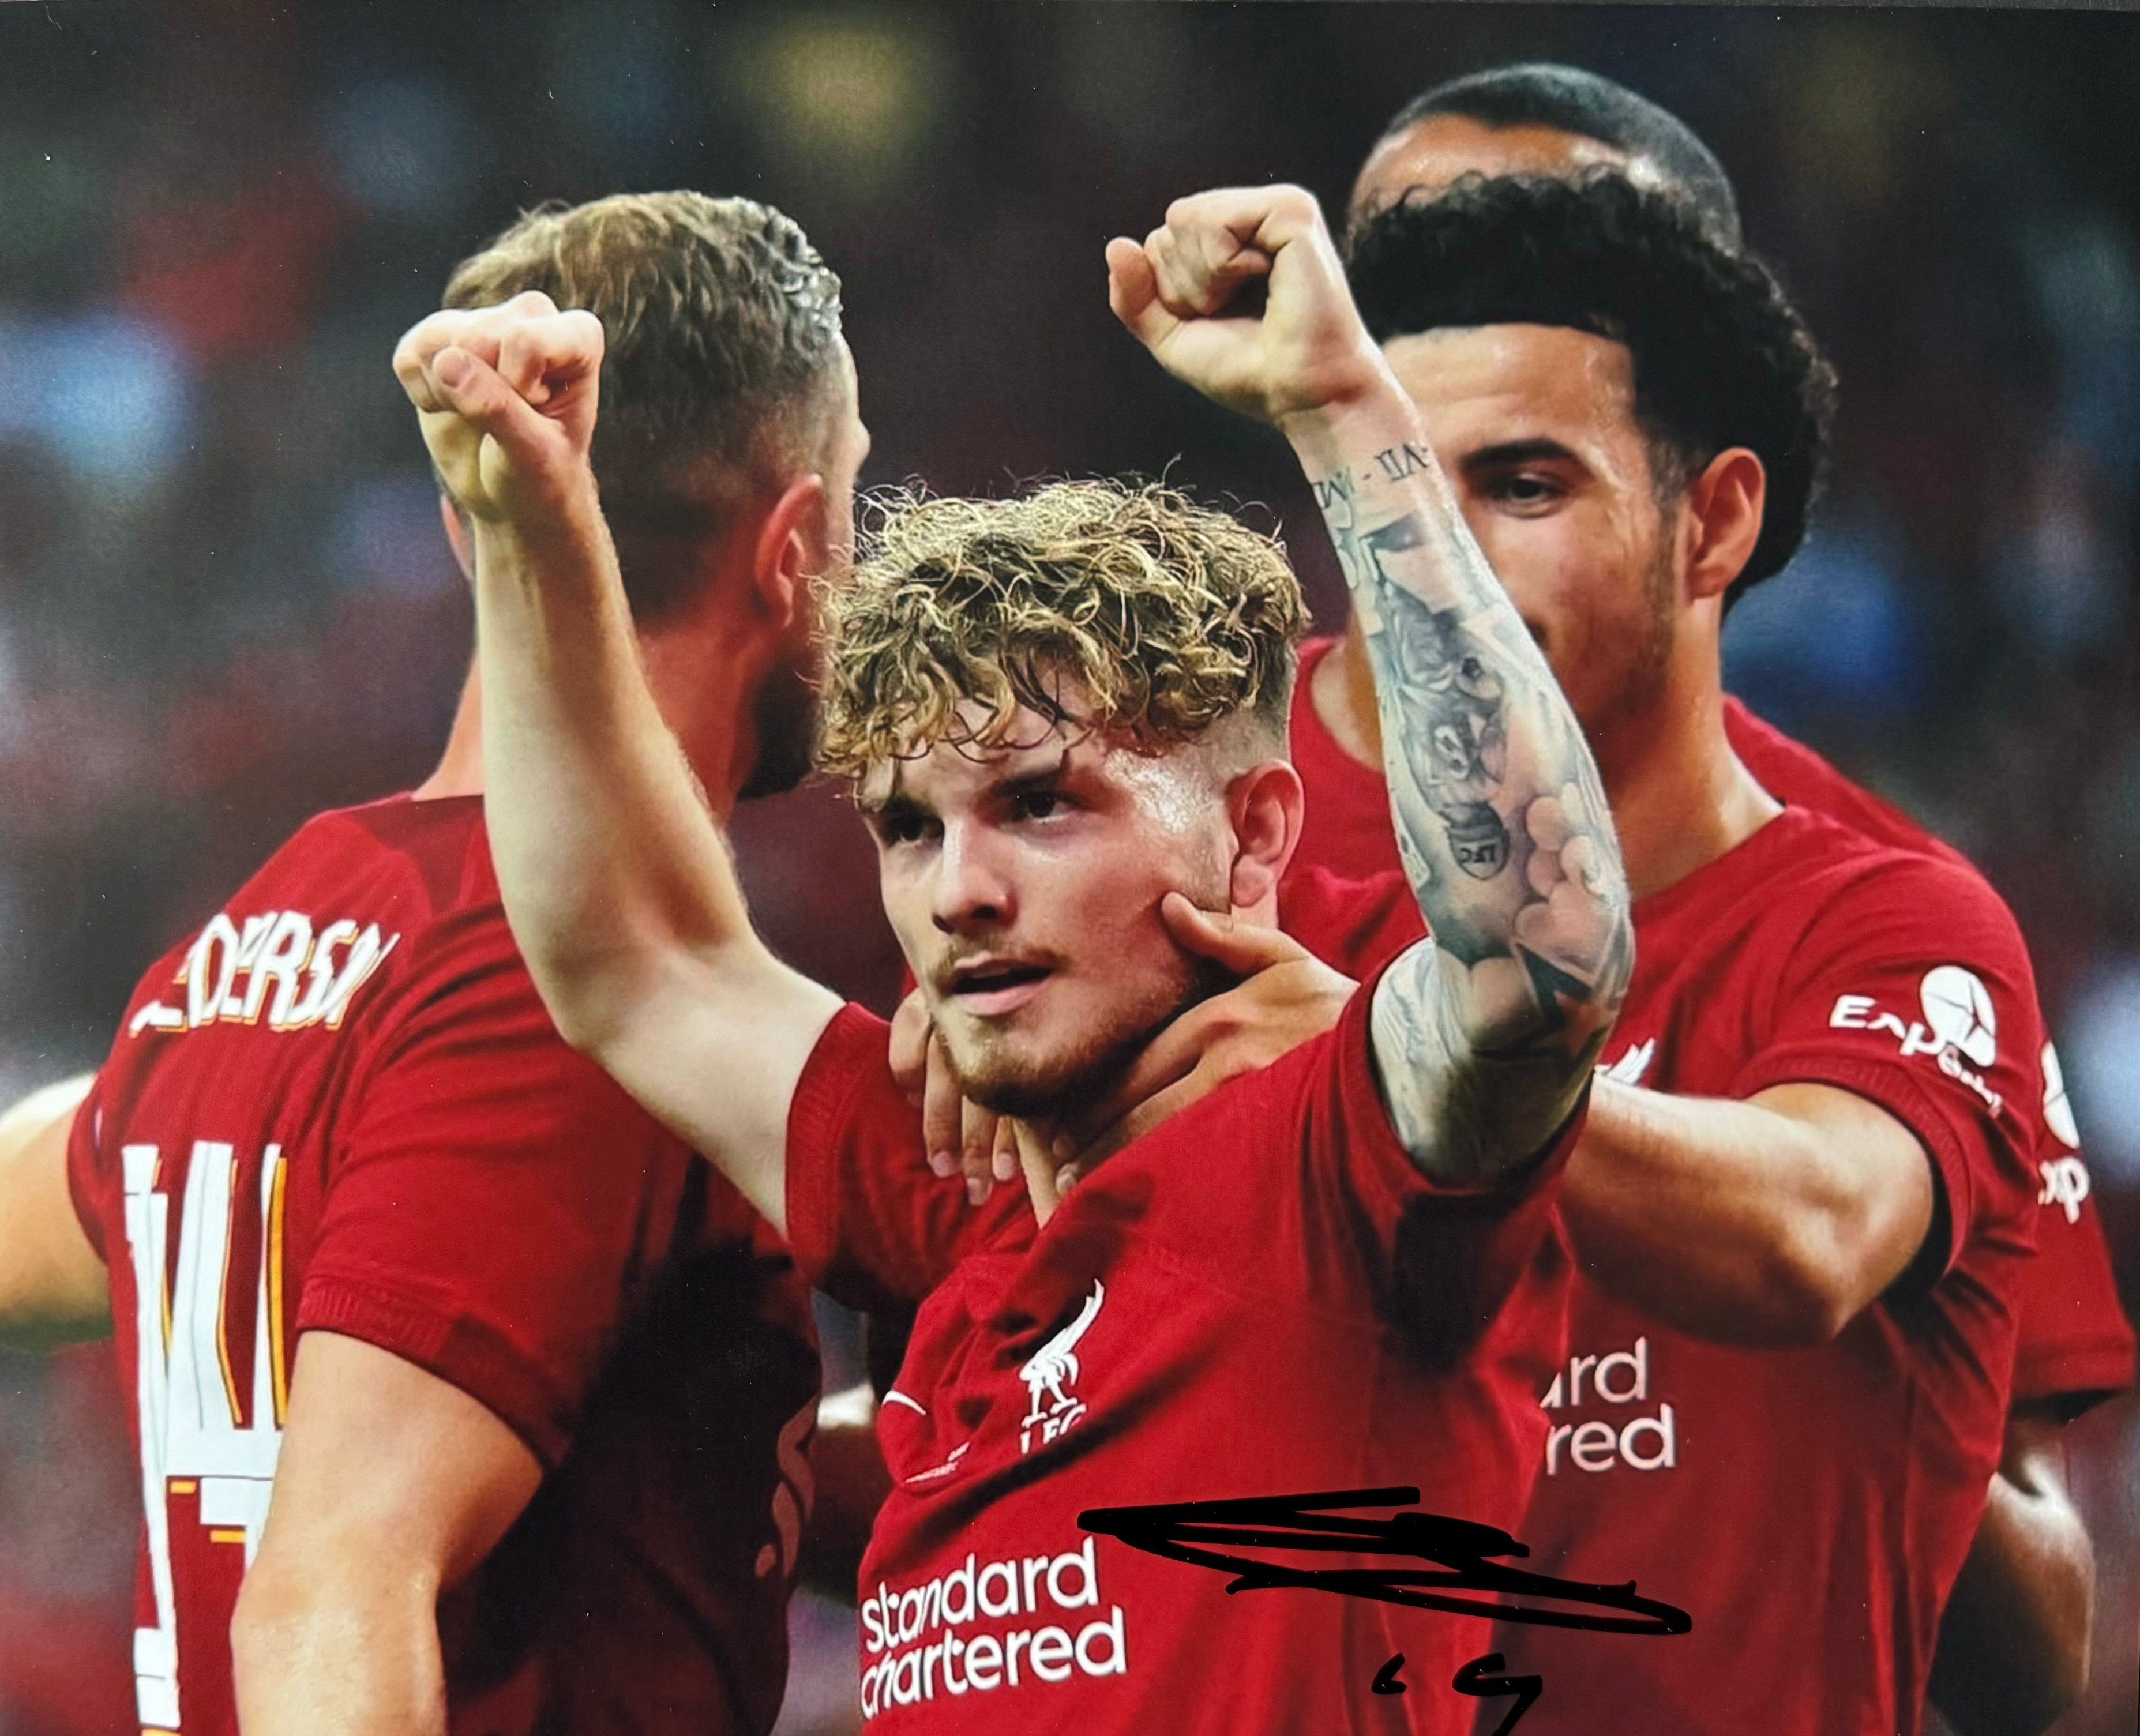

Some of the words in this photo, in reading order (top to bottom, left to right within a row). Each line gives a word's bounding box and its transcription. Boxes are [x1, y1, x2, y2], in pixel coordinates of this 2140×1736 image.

[1546, 1402, 1676, 1475] red
[861, 1535, 1099, 1654] standard
[860, 1604, 1127, 1720] chartered
